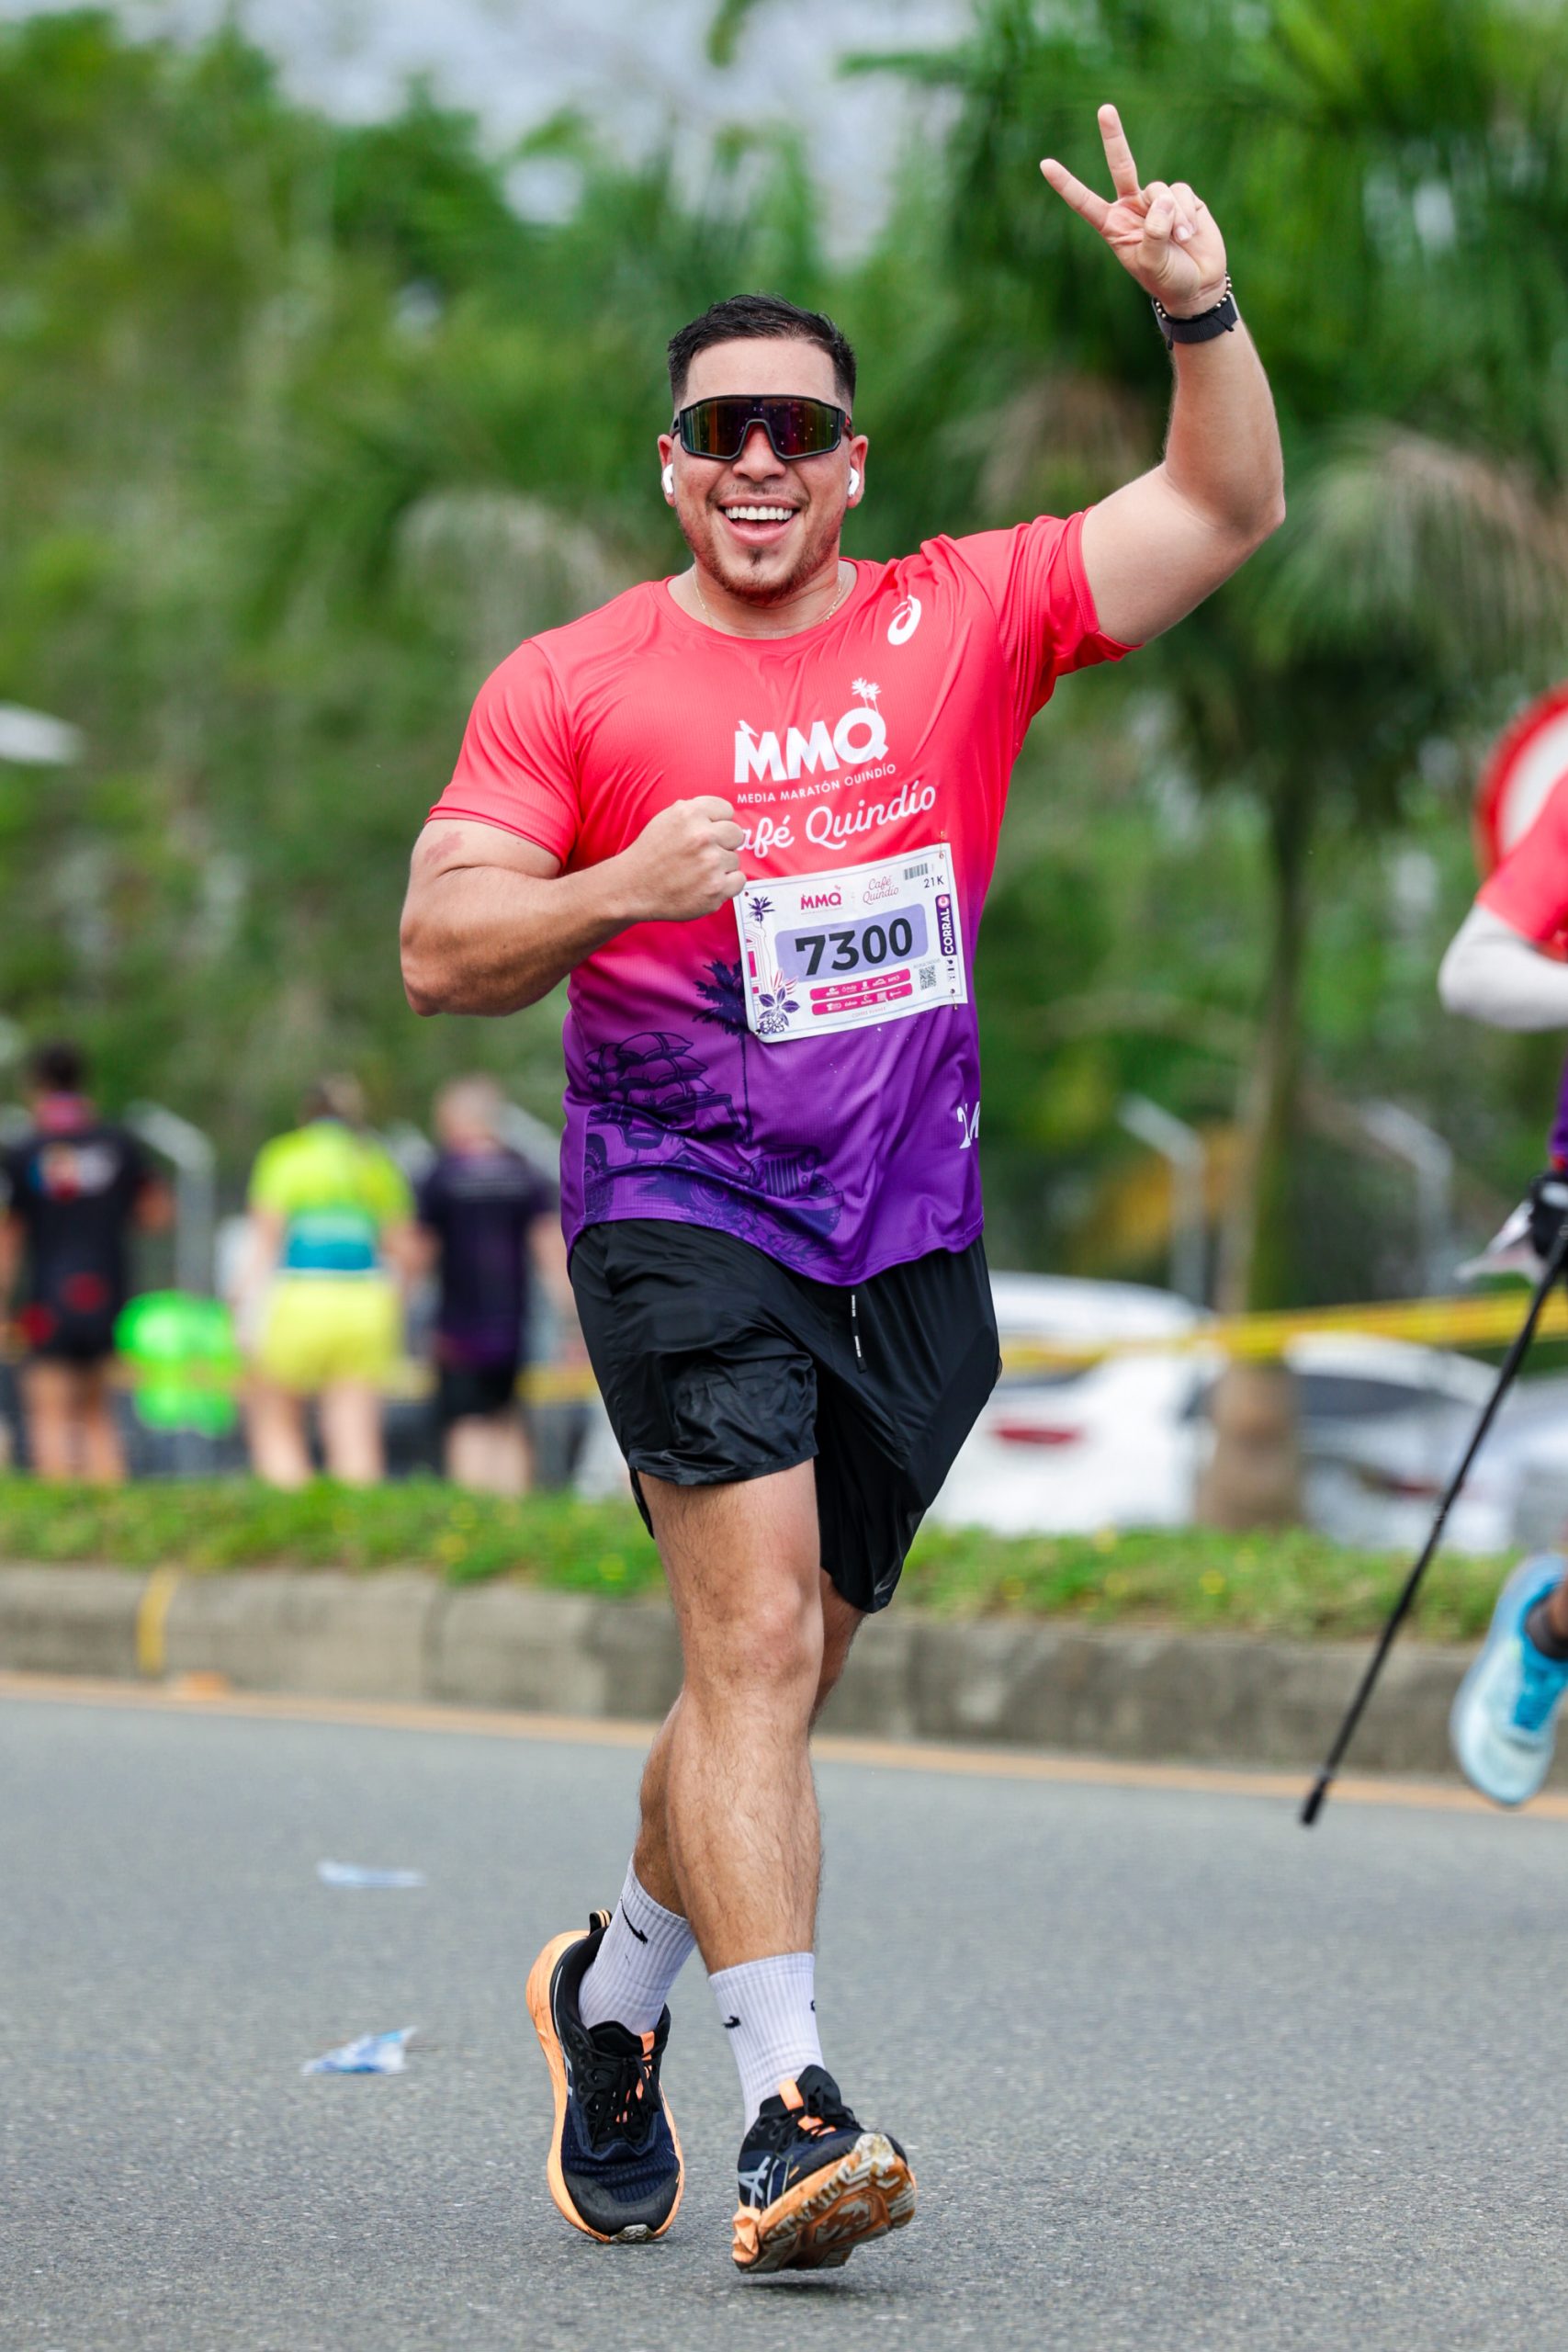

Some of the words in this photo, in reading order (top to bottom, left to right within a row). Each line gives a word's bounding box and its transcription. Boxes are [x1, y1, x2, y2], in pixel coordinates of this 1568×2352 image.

[734, 707, 889, 783] MMQ
[737, 794, 775, 804] MEDIA
[780, 779, 840, 801] MARATÓN
[843, 763, 897, 787] QUINDÍO
[806, 779, 936, 850] Quindío
[800, 891, 841, 910] MMQ
[863, 886, 899, 905] Quindío
[868, 875, 893, 891] Café
[924, 875, 944, 888] 21K
[795, 917, 913, 977] 7300
[941, 908, 953, 955] CORRAL
